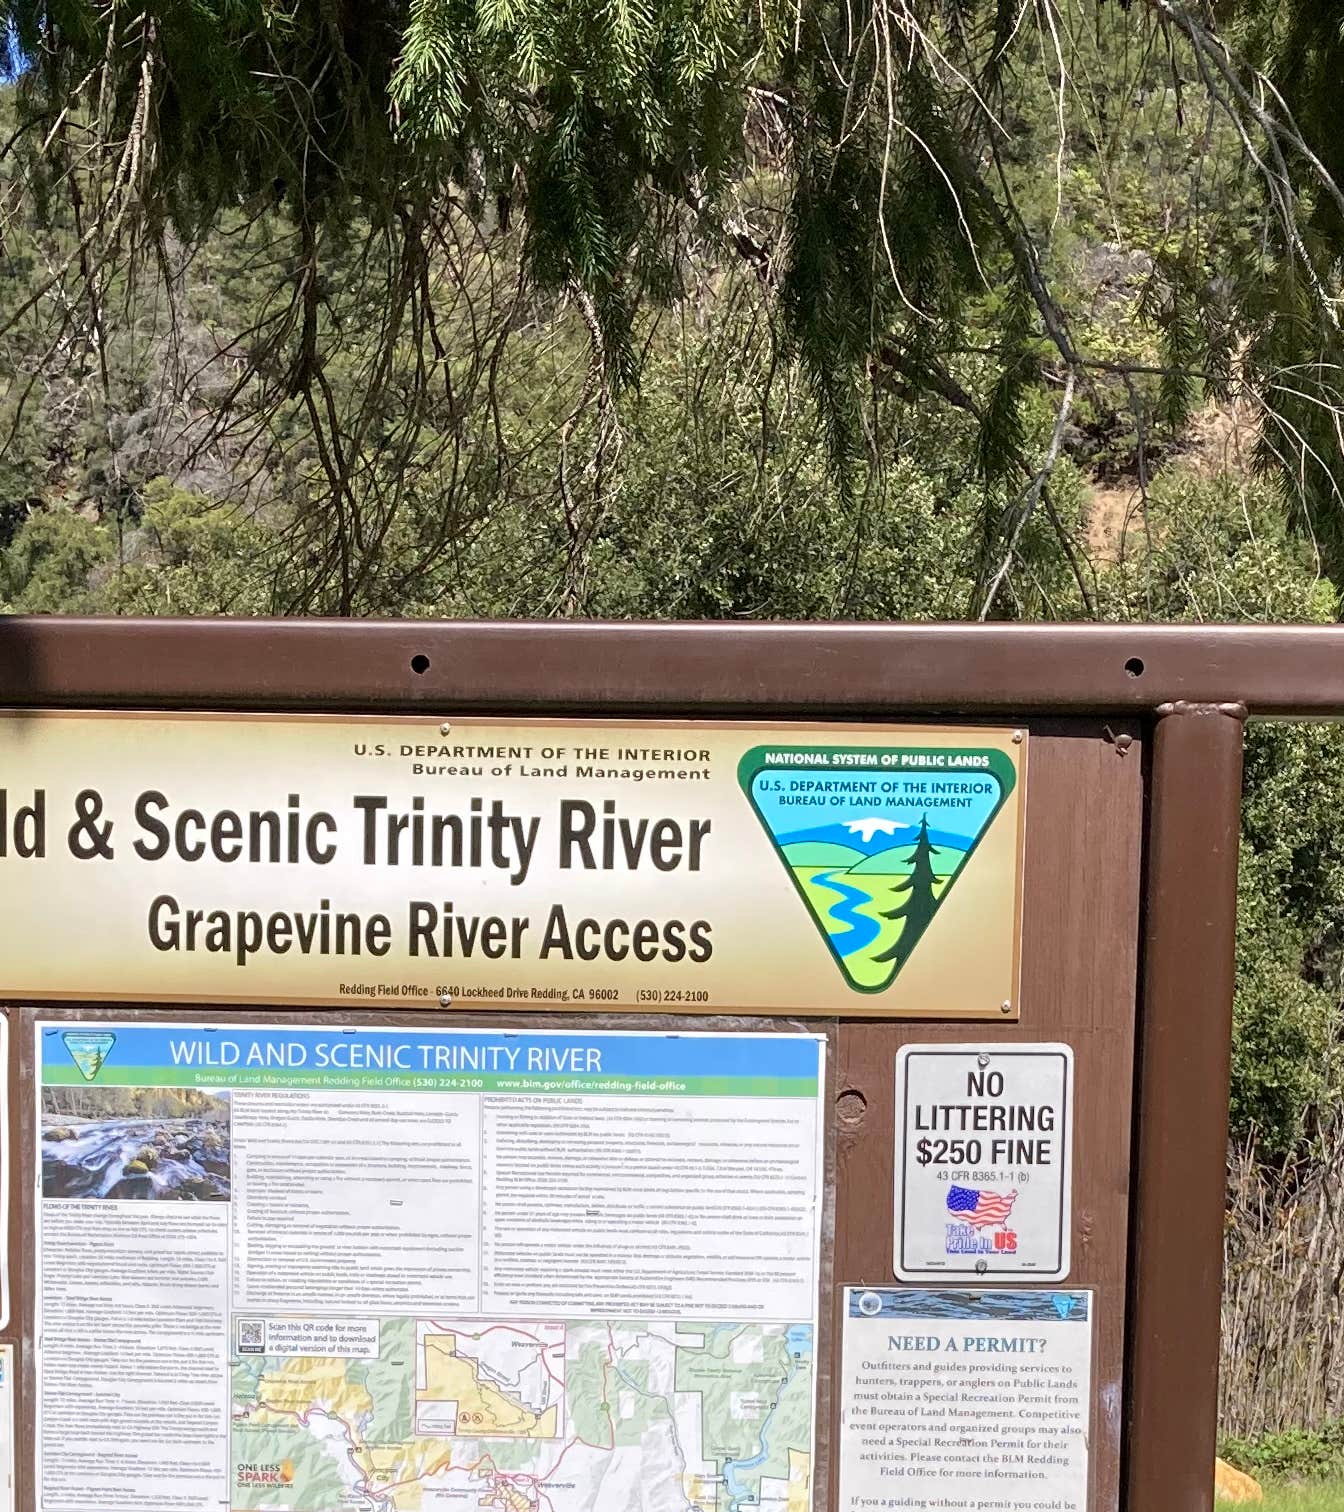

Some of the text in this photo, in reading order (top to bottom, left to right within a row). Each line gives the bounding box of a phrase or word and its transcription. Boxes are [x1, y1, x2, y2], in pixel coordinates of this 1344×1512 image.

[354, 744, 711, 762] U.S. DEPARTMENT OF THE INTERIOR
[765, 752, 989, 767] NATIONAL SYSTEM OF PUBLIC LANDS
[412, 763, 711, 782] Bureau of Land Management
[759, 780, 993, 794] U.S. DEPARTMENT OF THE INTERIOR
[779, 796, 973, 808] BUREAU OF LAND MANAGEMENT
[67, 788, 114, 861] &
[132, 790, 338, 865] Scenic
[354, 796, 541, 886] Trinity
[560, 799, 711, 872] River
[148, 894, 713, 966] Grapevine River Access
[340, 984, 375, 997] Redding
[378, 985, 399, 995] Field
[402, 985, 428, 996] Office
[462, 986, 504, 998] Lockheed
[507, 988, 528, 998] Drive
[531, 988, 570, 1001] Redding,
[573, 989, 584, 999] CA
[589, 990, 618, 1000] 96002
[636, 990, 662, 1002] (530)
[664, 991, 708, 1002] 224-2100
[170, 1040, 602, 1072] WILD AND SCENIC TRINITY RIVER
[195, 1074, 226, 1083] Bureau
[228, 1074, 237, 1083] of
[240, 1075, 260, 1084] Land
[264, 1076, 321, 1086] Management
[324, 1077, 359, 1087] Redding
[362, 1078, 383, 1086] Field
[385, 1078, 411, 1087] Office
[413, 1078, 437, 1088] (530)
[440, 1079, 483, 1088] 224-2100
[967, 1072, 1004, 1097] NO
[915, 1105, 1054, 1132] LITTERING
[916, 1137, 1051, 1167] $250 FINE
[937, 1172, 949, 1181] 43
[952, 1172, 970, 1181] CFR
[888, 1336, 1047, 1353] NEED A PERMIT?
[862, 1361, 1072, 1374] Outfitters and guides providing services to
[237, 1463, 280, 1473] ONE LESS
[237, 1472, 279, 1483] SPARK
